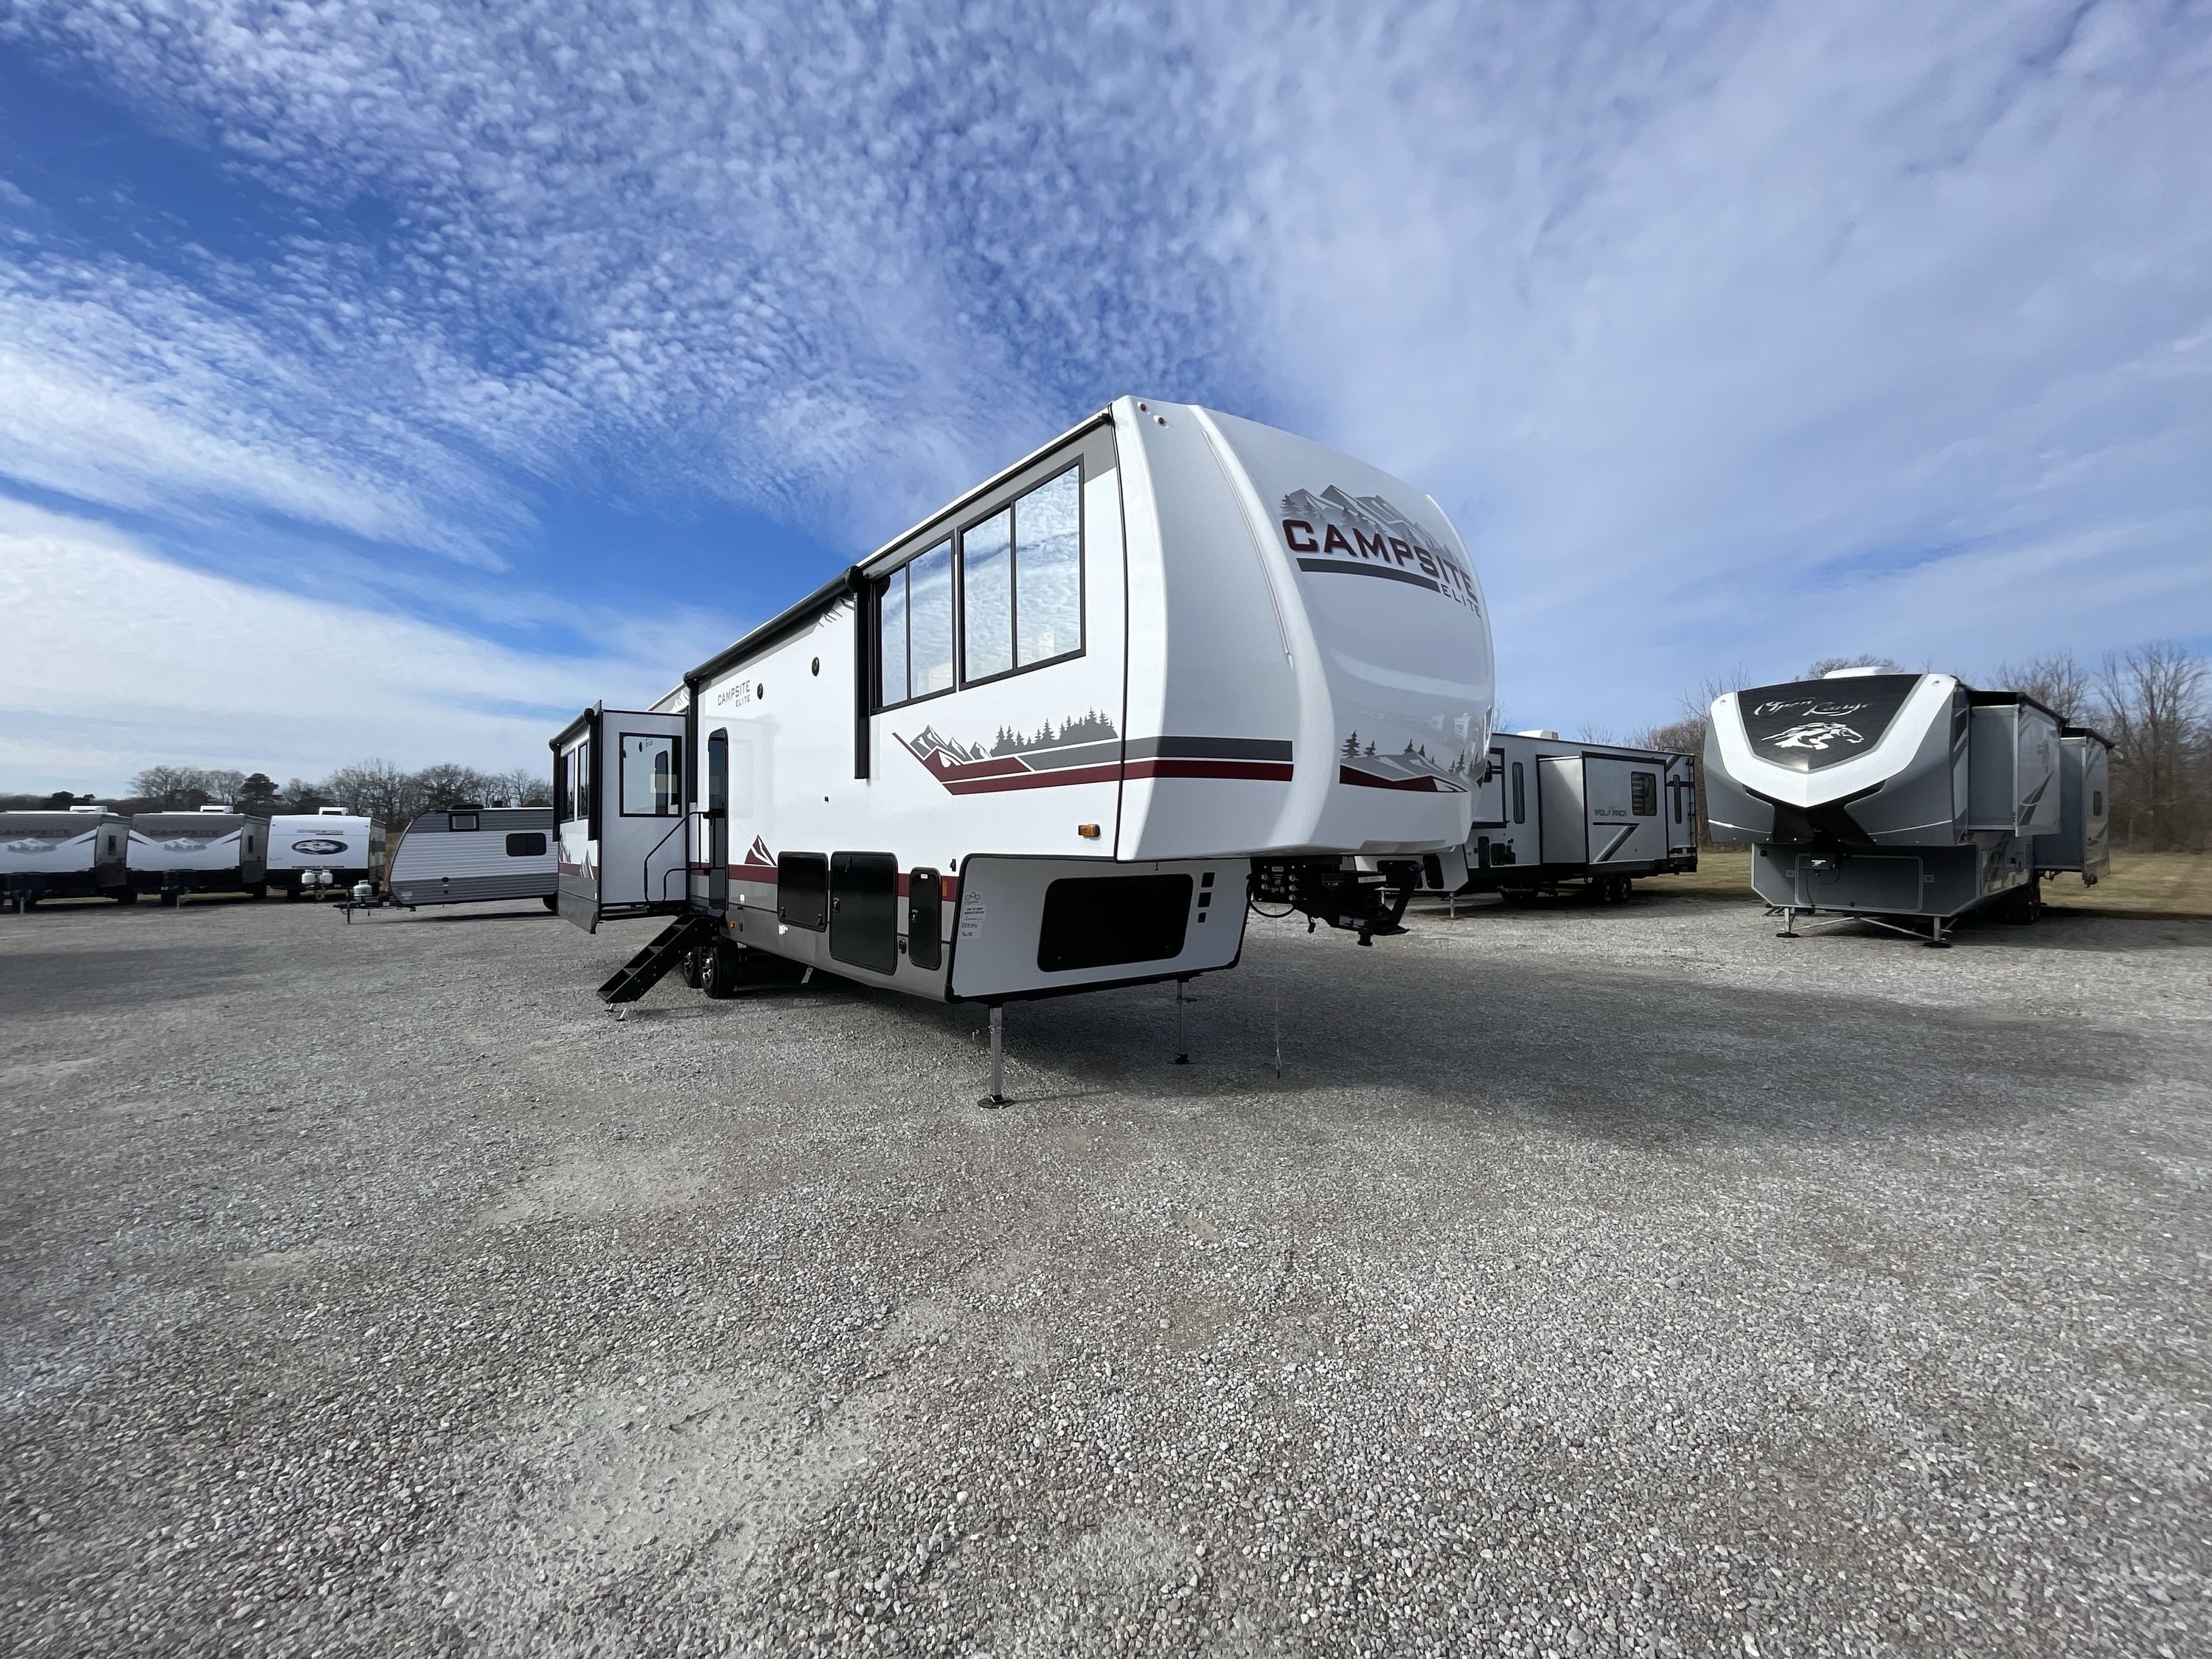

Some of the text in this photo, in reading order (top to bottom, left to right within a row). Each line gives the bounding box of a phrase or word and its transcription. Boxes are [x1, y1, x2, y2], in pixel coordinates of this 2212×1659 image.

[1282, 519, 1478, 604] CAMPSITE
[1441, 583, 1481, 619] ELITE
[717, 679, 751, 706] CAMPSITE
[735, 694, 751, 707] ELITE
